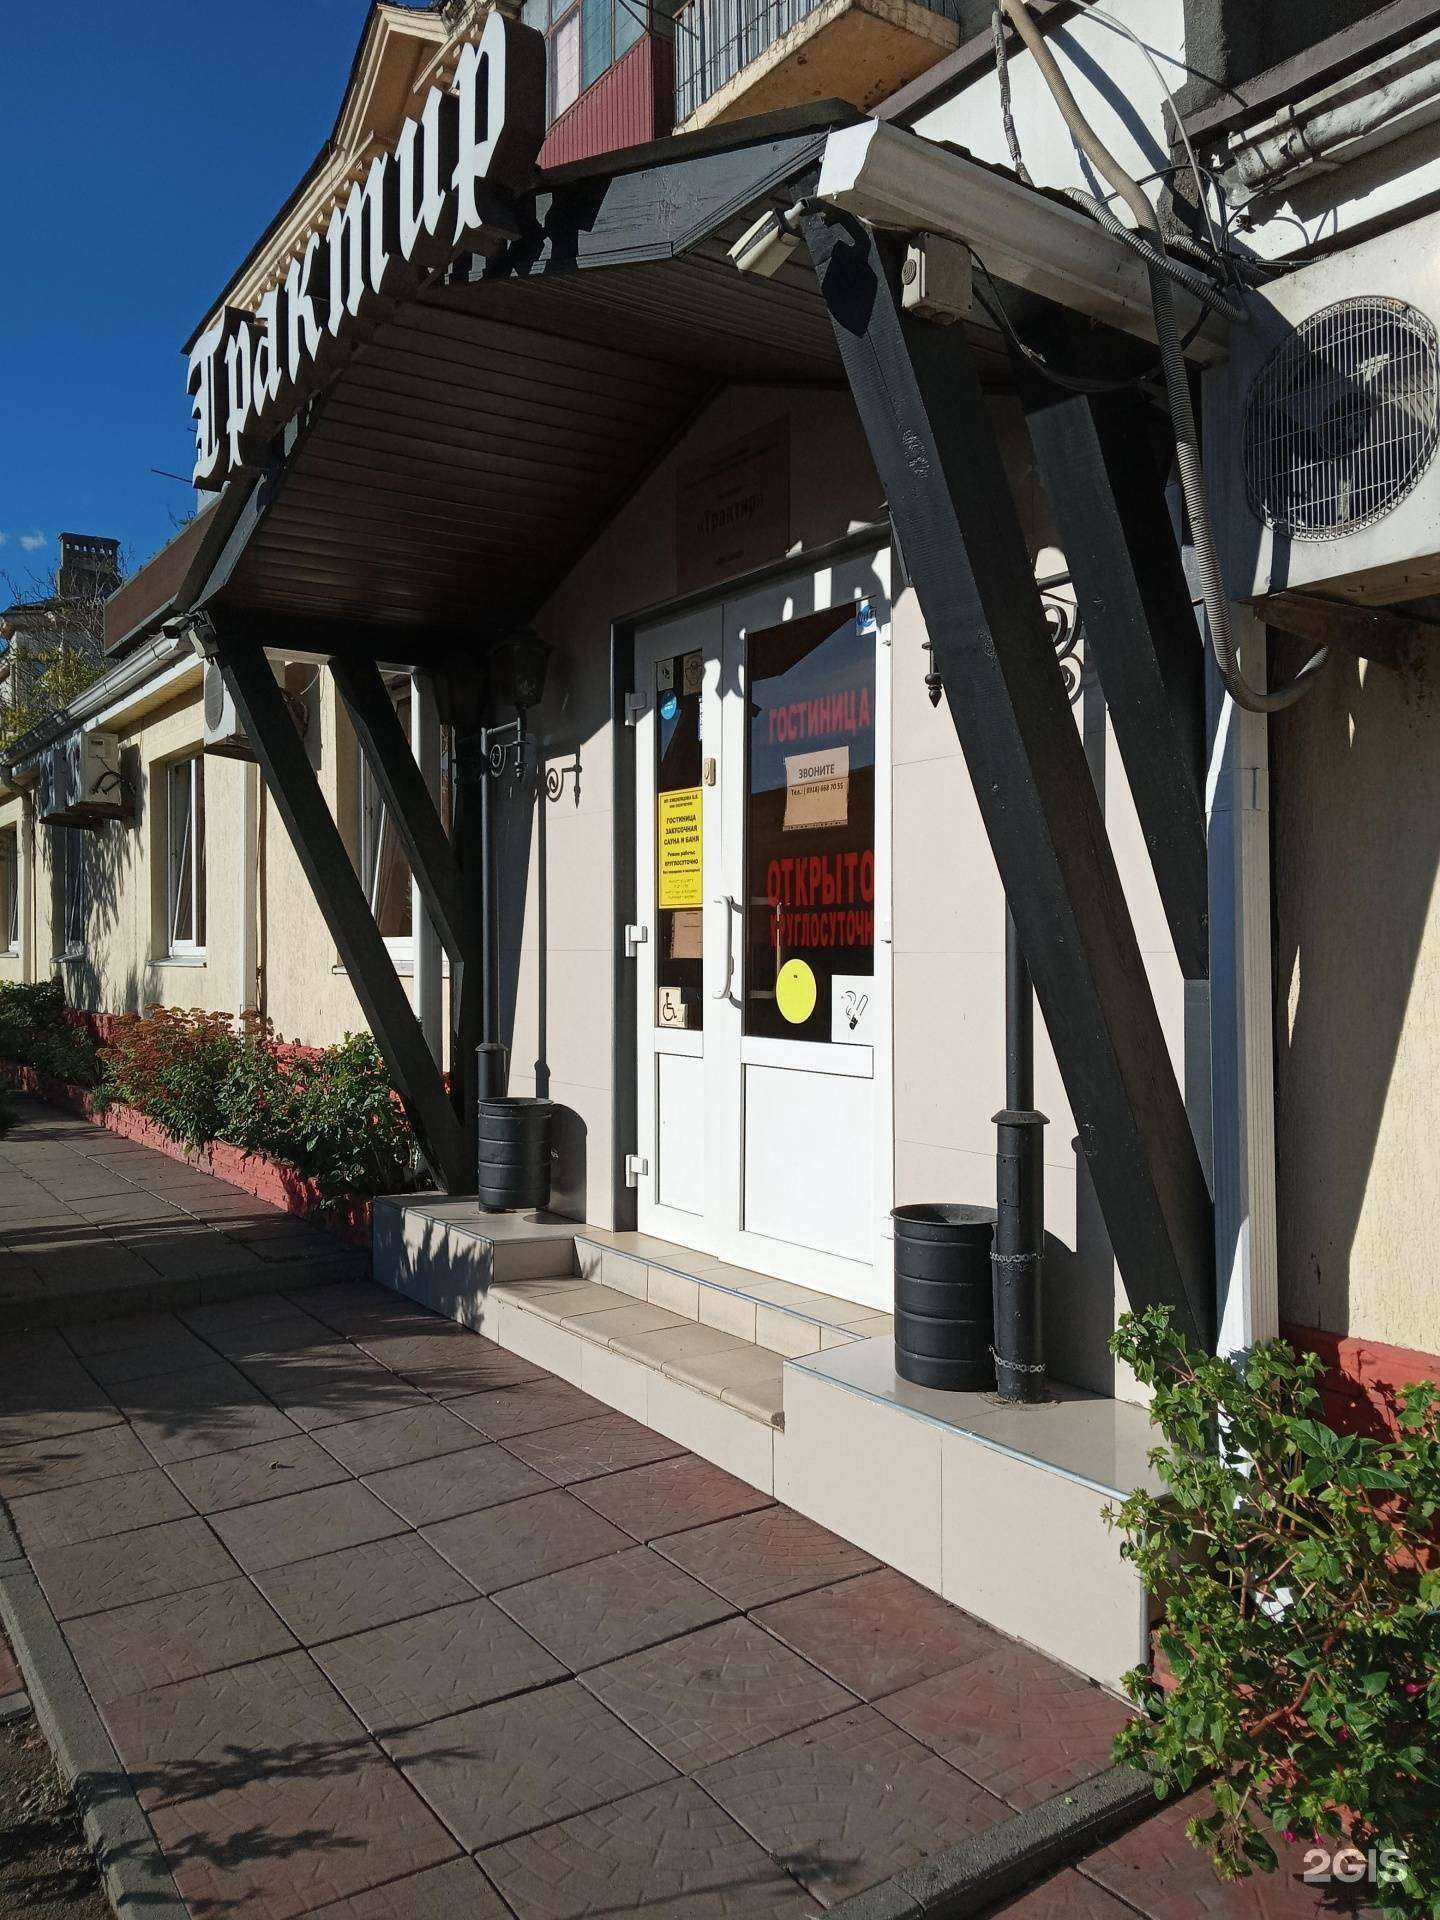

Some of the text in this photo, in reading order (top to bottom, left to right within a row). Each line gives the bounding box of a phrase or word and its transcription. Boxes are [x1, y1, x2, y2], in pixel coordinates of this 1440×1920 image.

[187, 11, 506, 479] Трактир
[769, 688, 870, 743] ГОСТИНИЦА
[799, 764, 835, 778] ЗВОНИТЕ
[667, 814, 696, 825] ГОСТИНИЦА
[767, 849, 874, 907] ОТКРЫТО
